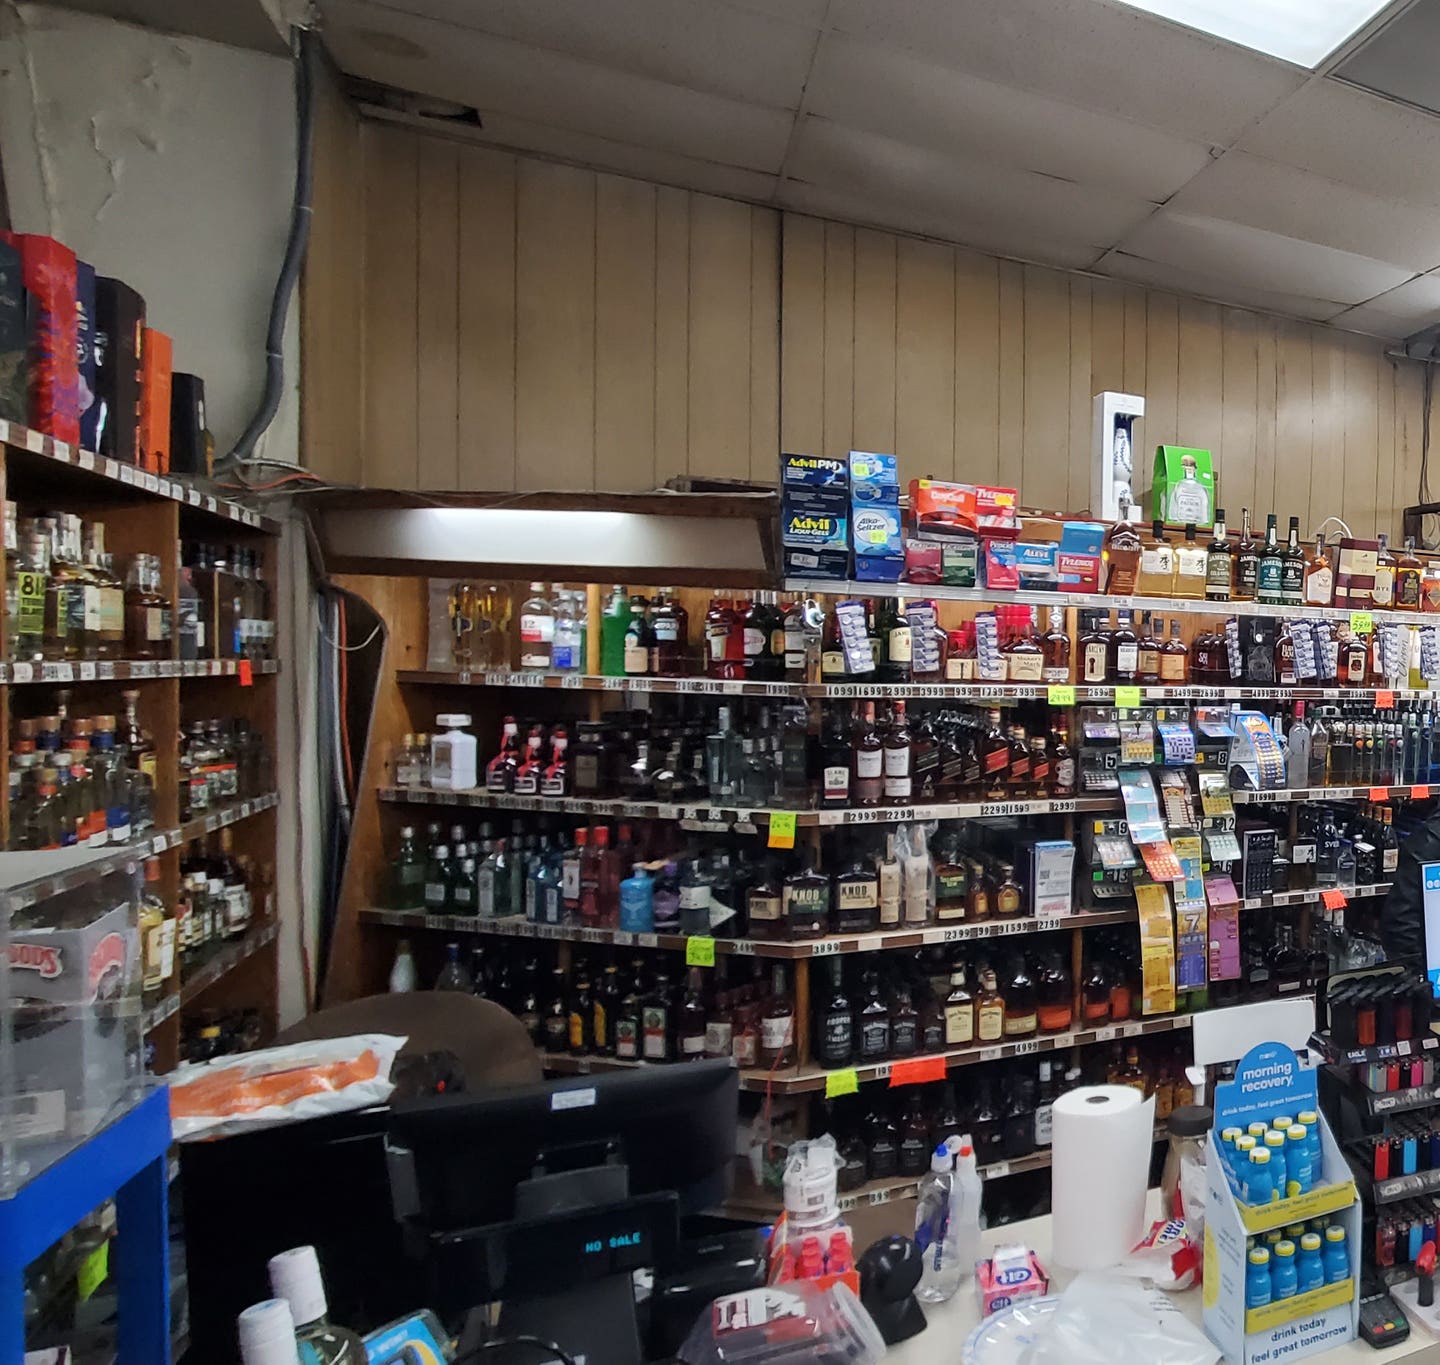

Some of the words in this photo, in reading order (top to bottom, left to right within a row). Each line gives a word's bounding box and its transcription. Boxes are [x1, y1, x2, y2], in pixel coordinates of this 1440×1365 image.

[788, 458, 817, 468] Advil
[818, 460, 837, 470] PM
[789, 517, 830, 530] Advil
[1107, 756, 1116, 768] 5
[1220, 752, 1227, 764] 8
[851, 811, 876, 822] 2999
[1120, 822, 1128, 834] 9
[1222, 818, 1235, 831] 12
[792, 889, 819, 900] KNOB
[842, 885, 867, 895] KNOB
[1185, 914, 1200, 933] 7
[1243, 1062, 1292, 1081] morning
[1242, 1075, 1294, 1093] recovery
[585, 1241, 602, 1254] NO
[609, 1231, 641, 1248] SALE
[1271, 1326, 1297, 1342] drink
[1299, 1316, 1327, 1333] today
[1251, 1349, 1270, 1365] feel
[1272, 1339, 1299, 1359] great
[1300, 1324, 1348, 1345] tomorrow
